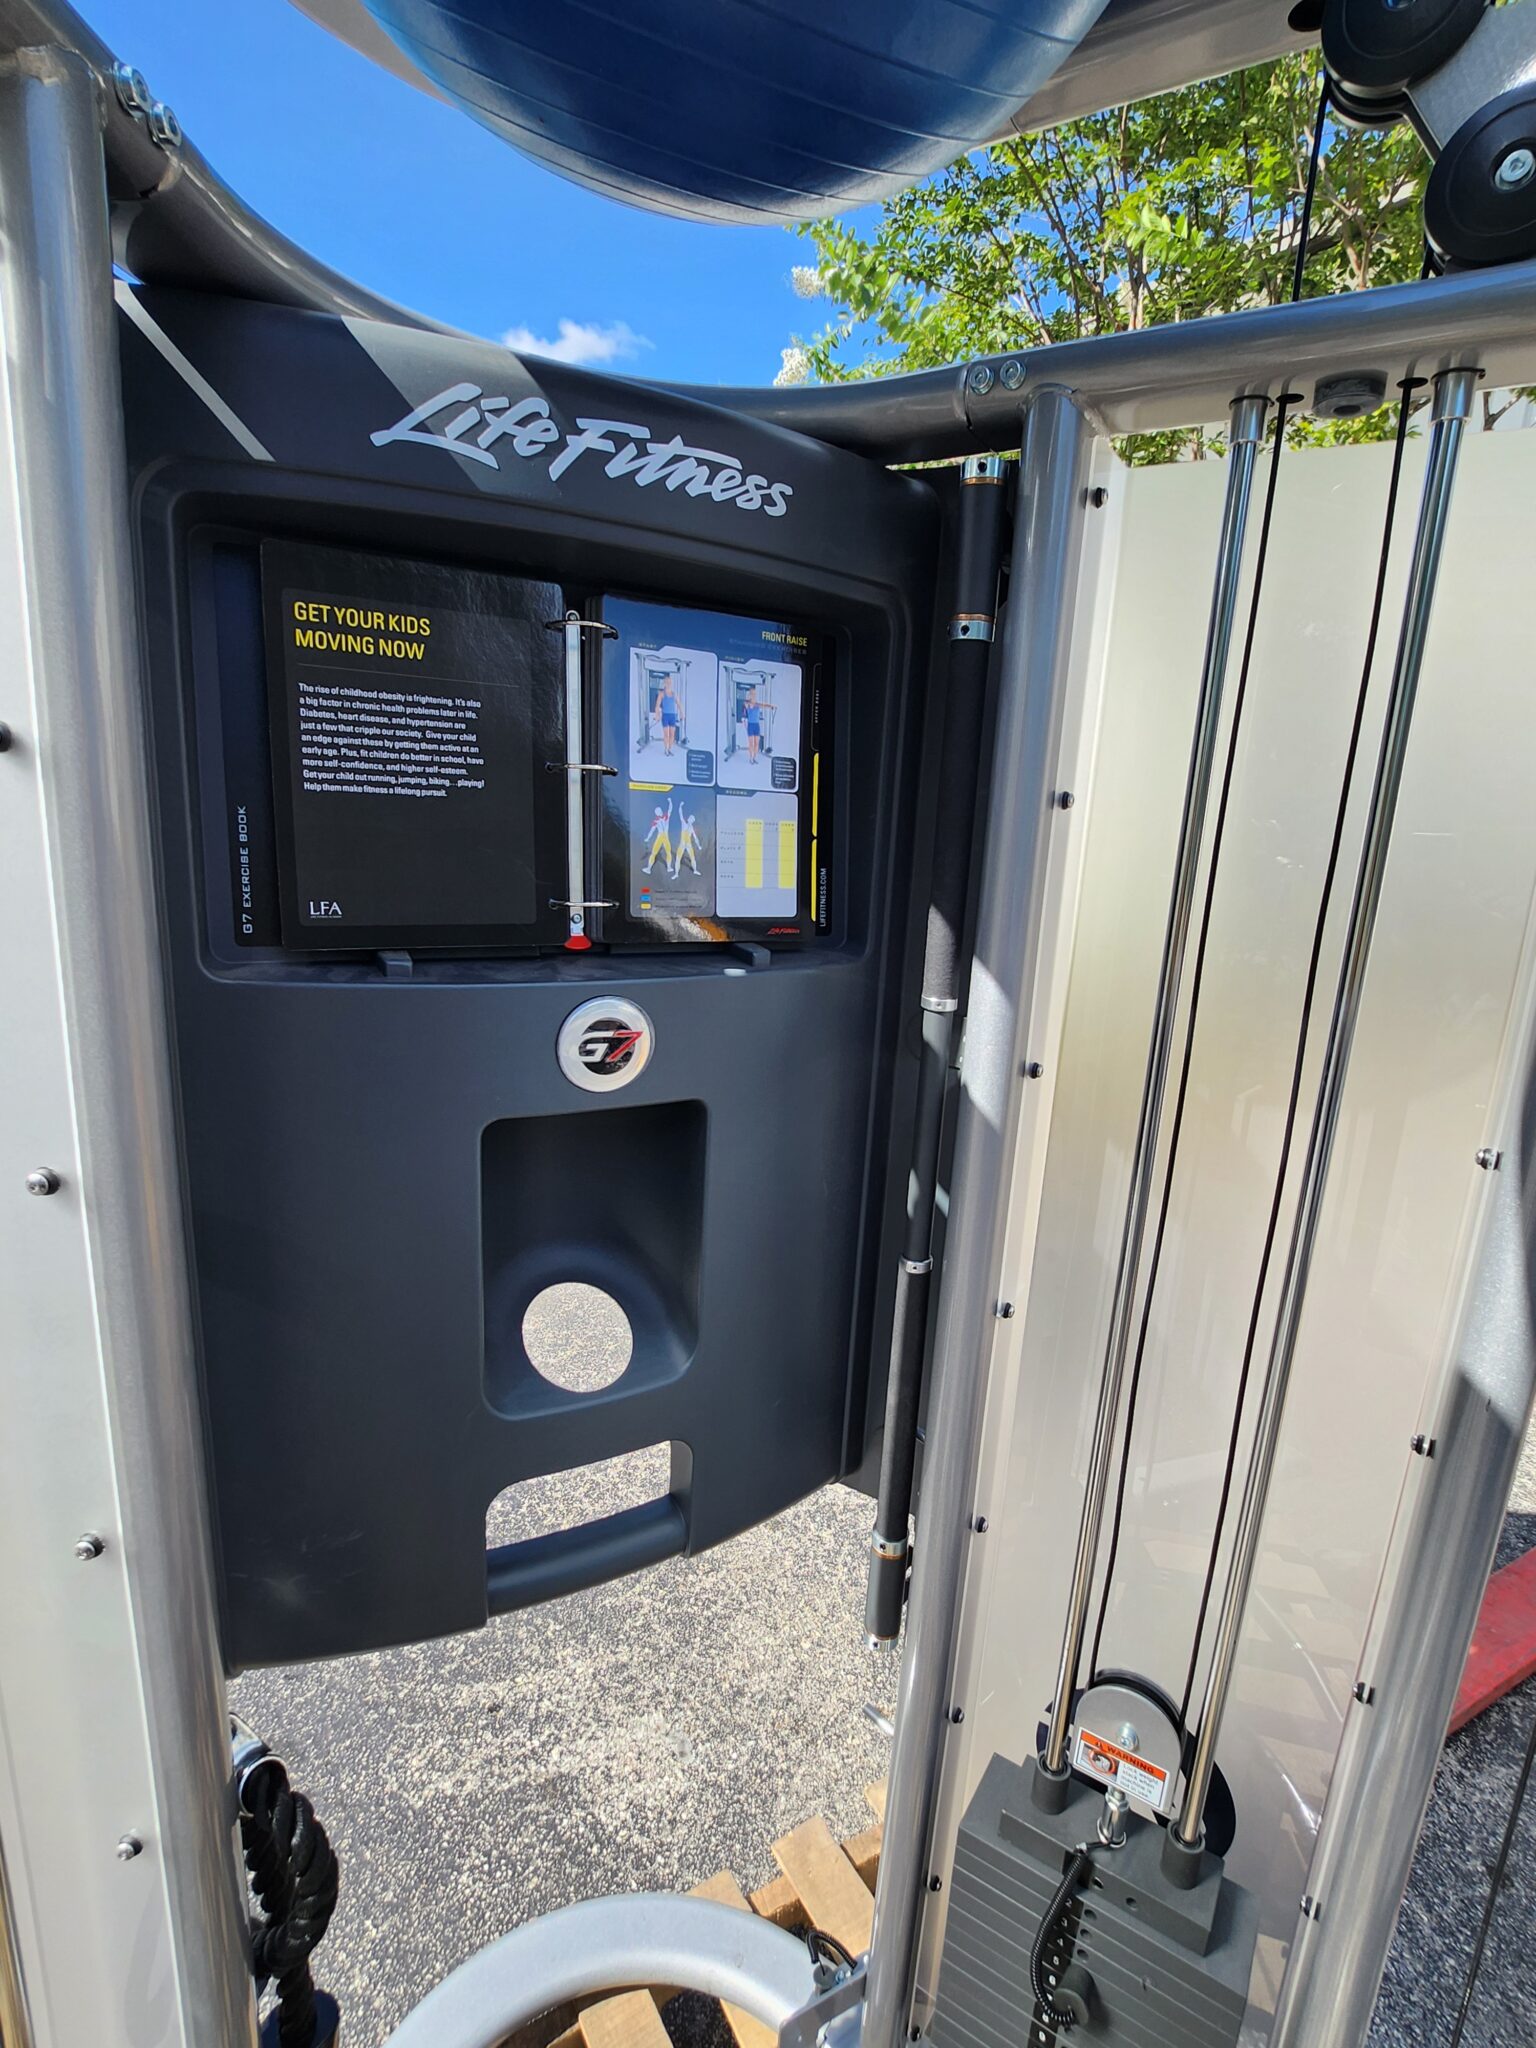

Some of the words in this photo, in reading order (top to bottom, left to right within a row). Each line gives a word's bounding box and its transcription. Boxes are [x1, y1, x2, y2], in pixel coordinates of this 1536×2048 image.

[370, 382, 560, 470] Life
[548, 418, 793, 517] Fitness
[294, 601, 331, 623] GET
[333, 606, 385, 630] YOUR
[388, 613, 431, 636] KIDS
[295, 628, 374, 655] MOVING
[379, 638, 425, 660] NOW
[761, 631, 785, 644] FRONT
[786, 635, 808, 647] RAISE
[298, 682, 314, 693] The
[315, 685, 330, 694] rise
[331, 686, 339, 695] of
[340, 688, 378, 699] childhood
[378, 691, 405, 702] obesity
[406, 694, 412, 702] is
[413, 694, 454, 707] frightening.
[466, 699, 481, 708] also
[299, 697, 305, 705] a
[306, 696, 318, 707] big
[319, 697, 342, 707] factor
[343, 700, 351, 708] in
[352, 700, 381, 711] chronic
[381, 703, 405, 713] health
[406, 706, 440, 716] problems
[440, 708, 457, 717] later
[457, 710, 465, 718] in
[465, 710, 478, 719] life.
[300, 707, 337, 720] Diabetes,
[338, 711, 359, 721] heart
[359, 714, 391, 725] disease,
[392, 717, 406, 725] and
[406, 718, 453, 729] hypertension
[454, 722, 466, 730] are
[300, 721, 316, 731] just
[322, 722, 338, 731] few
[338, 724, 354, 733] that
[354, 726, 381, 736] cripple
[381, 728, 394, 736] our
[395, 729, 424, 739] society.
[425, 730, 442, 739] Give
[442, 733, 459, 741] your
[459, 733, 477, 742] child
[301, 734, 312, 742] an
[312, 735, 332, 745] edge
[333, 736, 362, 746] against
[362, 738, 384, 747] these
[384, 739, 394, 749] by
[394, 741, 420, 751] getting
[420, 742, 439, 750] them
[439, 744, 461, 752] active
[301, 746, 323, 756] early
[323, 748, 340, 757] age.
[340, 747, 360, 758] Plus,
[360, 749, 368, 757] fit
[369, 750, 400, 759] children
[400, 752, 410, 760] do
[410, 753, 432, 761] better
[433, 754, 440, 762] in
[440, 755, 466, 764] school,
[467, 757, 484, 765] have
[302, 759, 323, 767] more
[324, 759, 385, 771] self-confidence,
[401, 764, 424, 773] higher
[425, 765, 468, 775] self-esteem.
[303, 769, 317, 778] Get
[317, 772, 335, 780] your
[336, 771, 354, 780] child
[367, 774, 397, 784] running,
[398, 775, 428, 785] jumping,
[303, 781, 322, 792] Help
[322, 783, 342, 791] them
[342, 784, 363, 793] make
[363, 785, 388, 794] fitness
[394, 786, 421, 797] lifelong
[421, 789, 447, 797] pursuit.
[237, 805, 248, 842] BOOK
[240, 847, 252, 908] EXERCISE
[309, 901, 342, 916] LFA
[819, 867, 827, 927] LIFEFITNESS.COM
[242, 913, 253, 934] G7
[578, 1031, 644, 1063] G7
[1107, 1745, 1154, 1774] WARNING
[1065, 1898, 1073, 1908] 2
